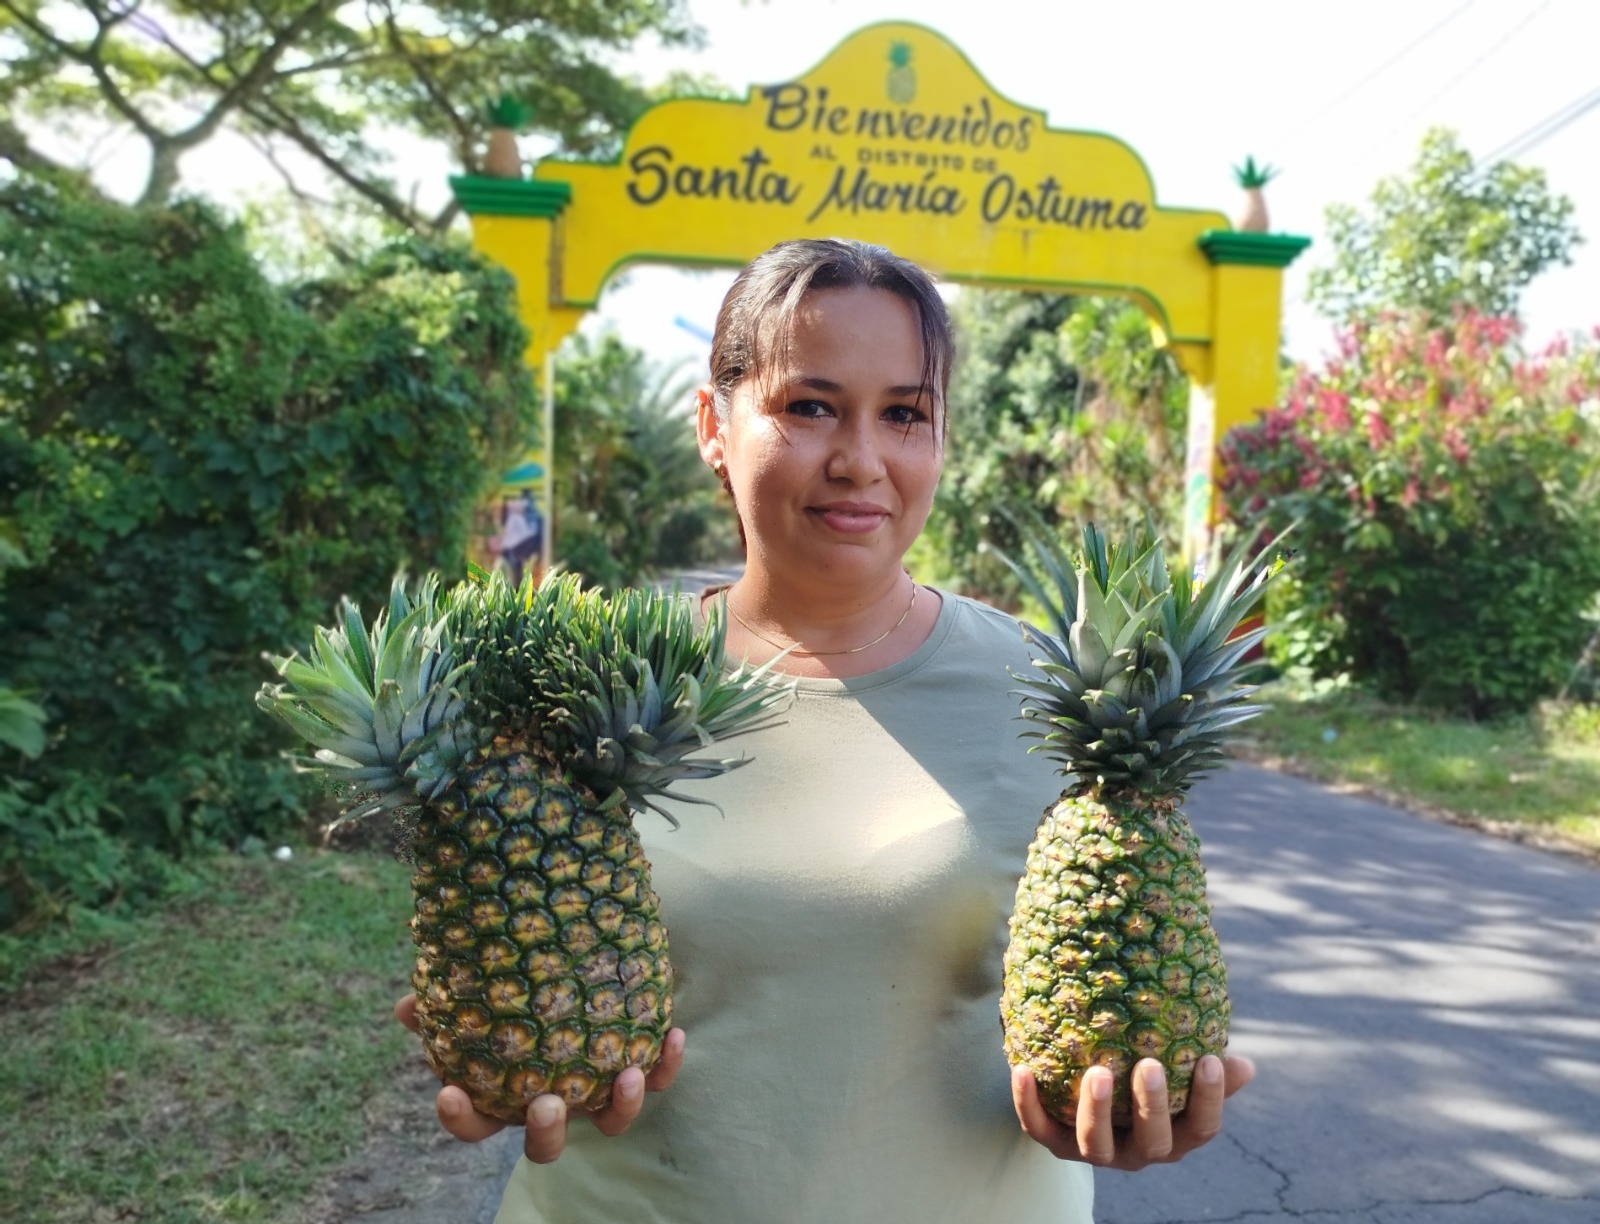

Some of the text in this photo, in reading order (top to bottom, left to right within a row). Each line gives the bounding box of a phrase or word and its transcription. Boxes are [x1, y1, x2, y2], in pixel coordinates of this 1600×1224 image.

[761, 82, 1034, 152] Bienvenidos
[626, 145, 1148, 230] Santa María Ostuma
[810, 145, 998, 174] AL DISTRITO DE
